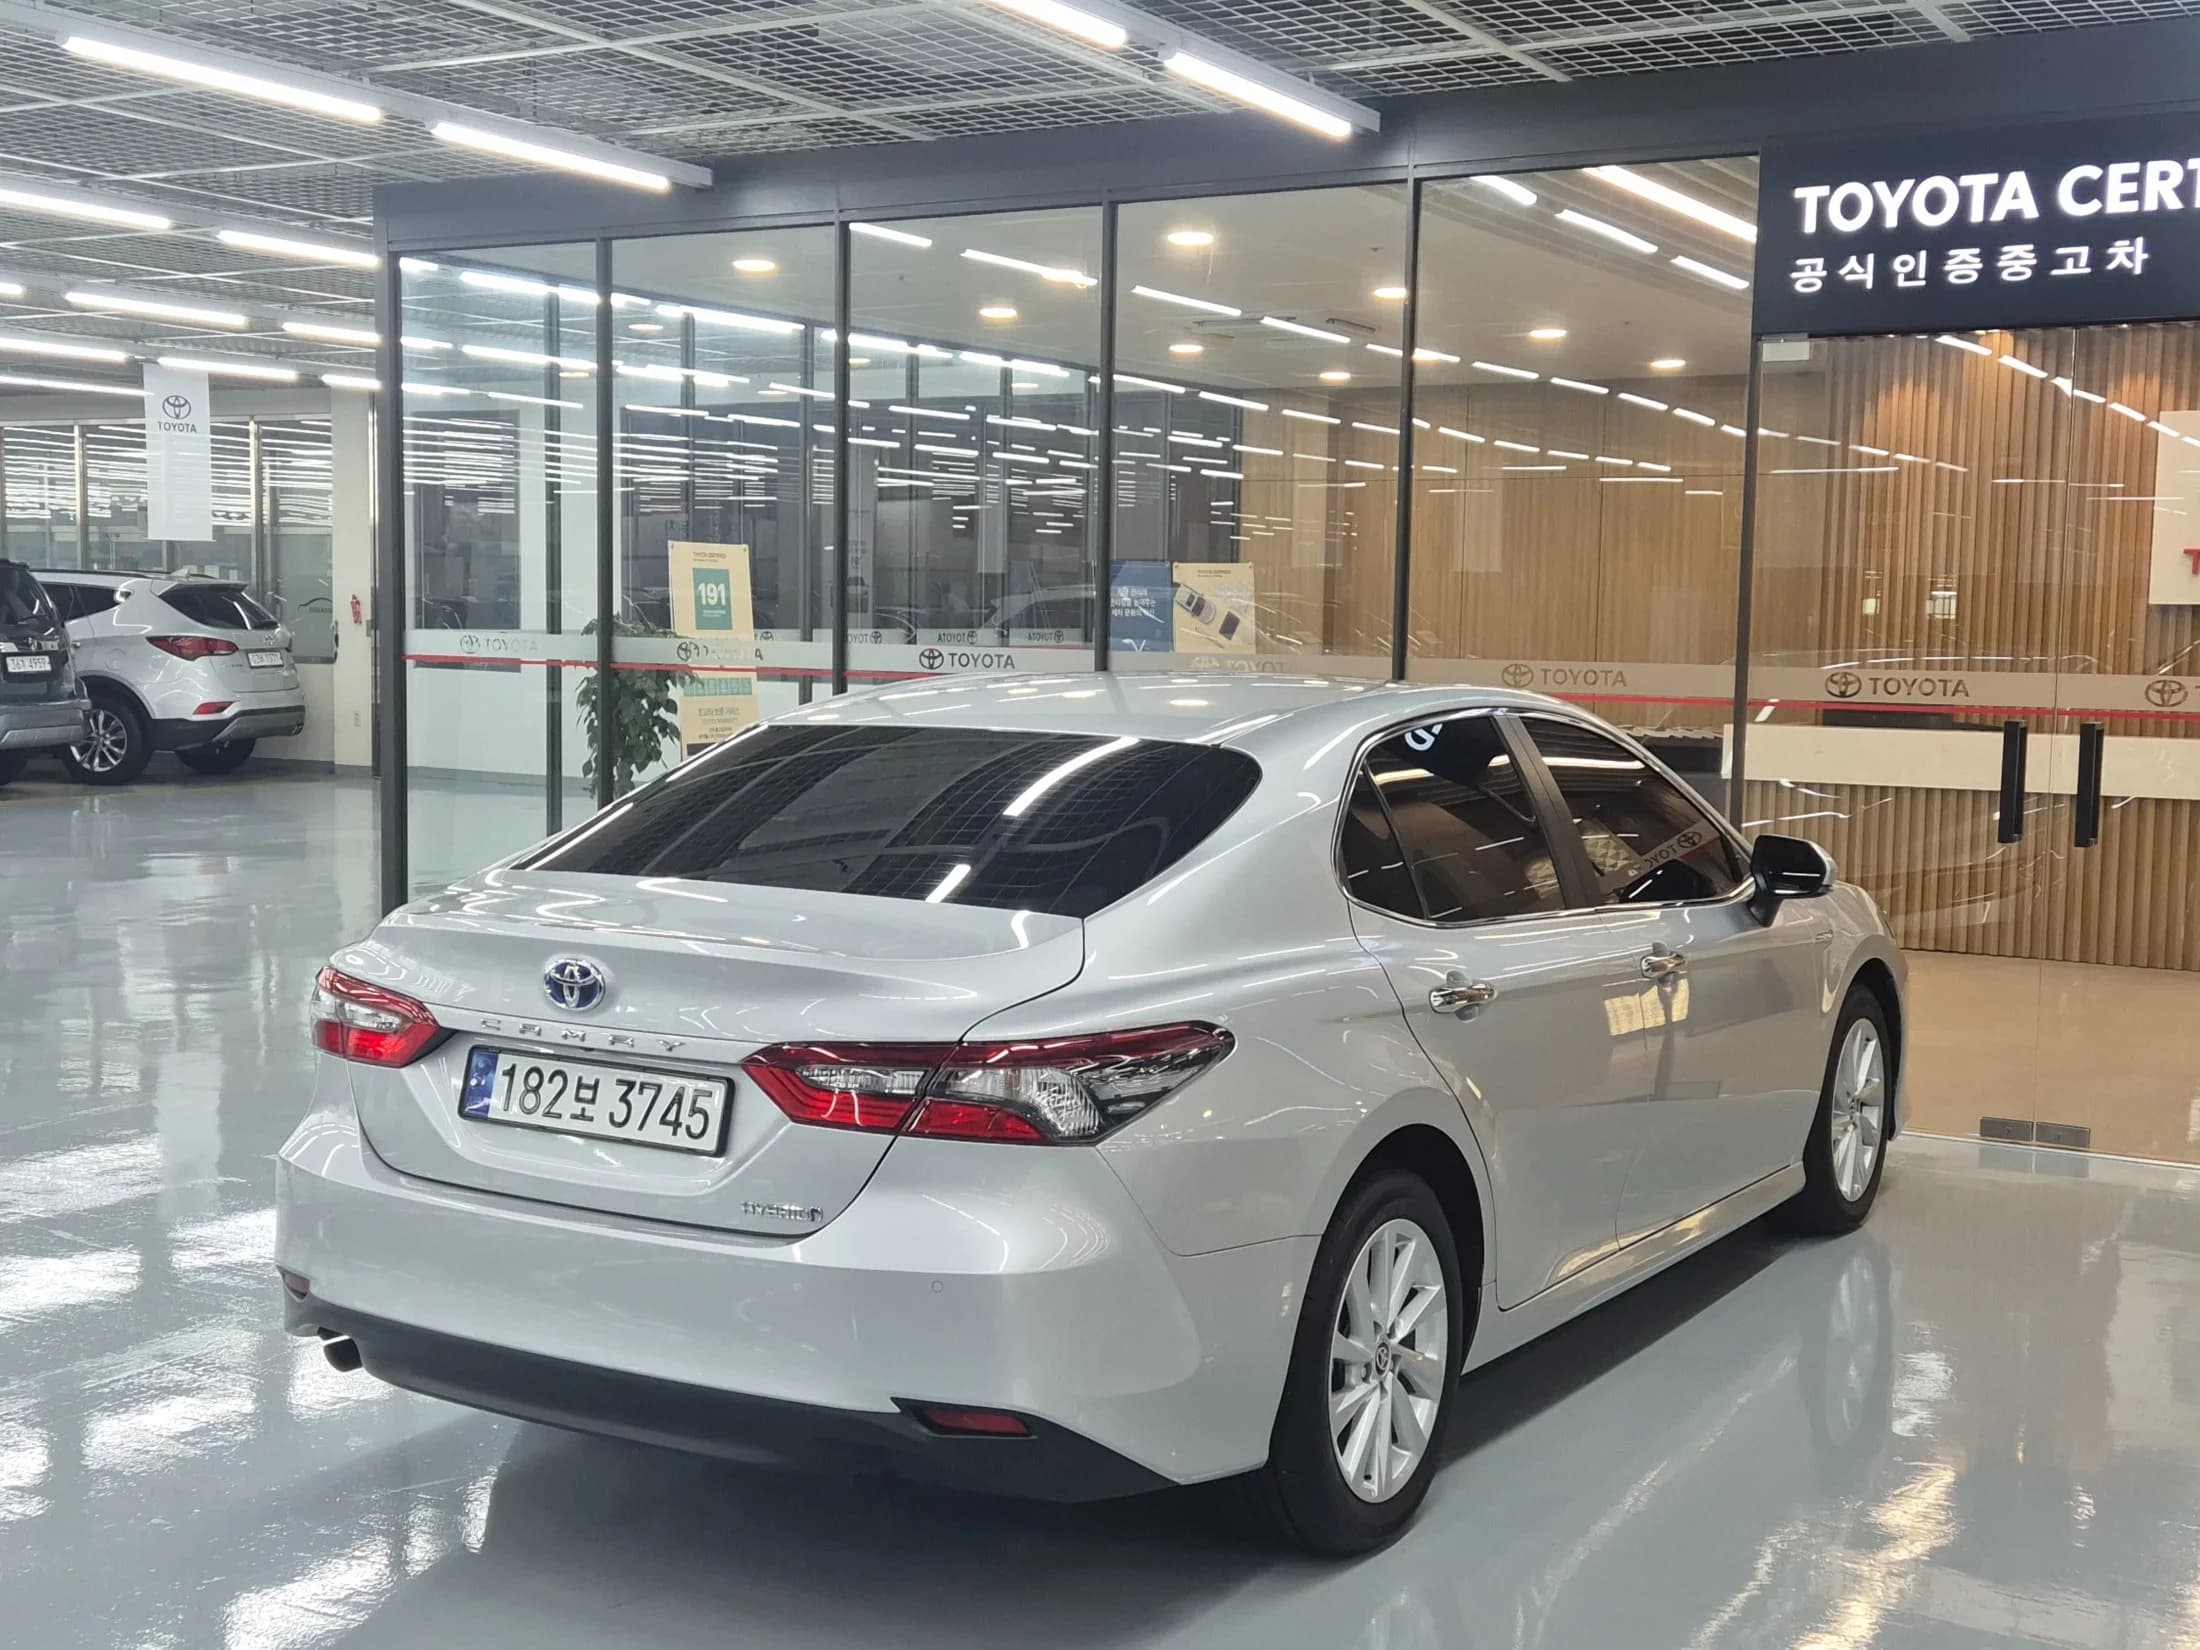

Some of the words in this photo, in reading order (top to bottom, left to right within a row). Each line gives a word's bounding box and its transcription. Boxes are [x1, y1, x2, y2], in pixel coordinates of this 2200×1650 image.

[1793, 171, 2039, 234] TOYOTA
[1789, 236, 2149, 294] 공식인증중고차
[157, 421, 198, 434] TOYOTA
[697, 582, 727, 606] 191
[948, 652, 1016, 669] TOYOTA
[1539, 667, 1627, 689] TOYOTA
[1868, 675, 1970, 699] TOYOTA
[481, 1017, 687, 1053] CAMRY
[501, 1062, 600, 1123] 182보
[608, 1078, 714, 1141] 3745
